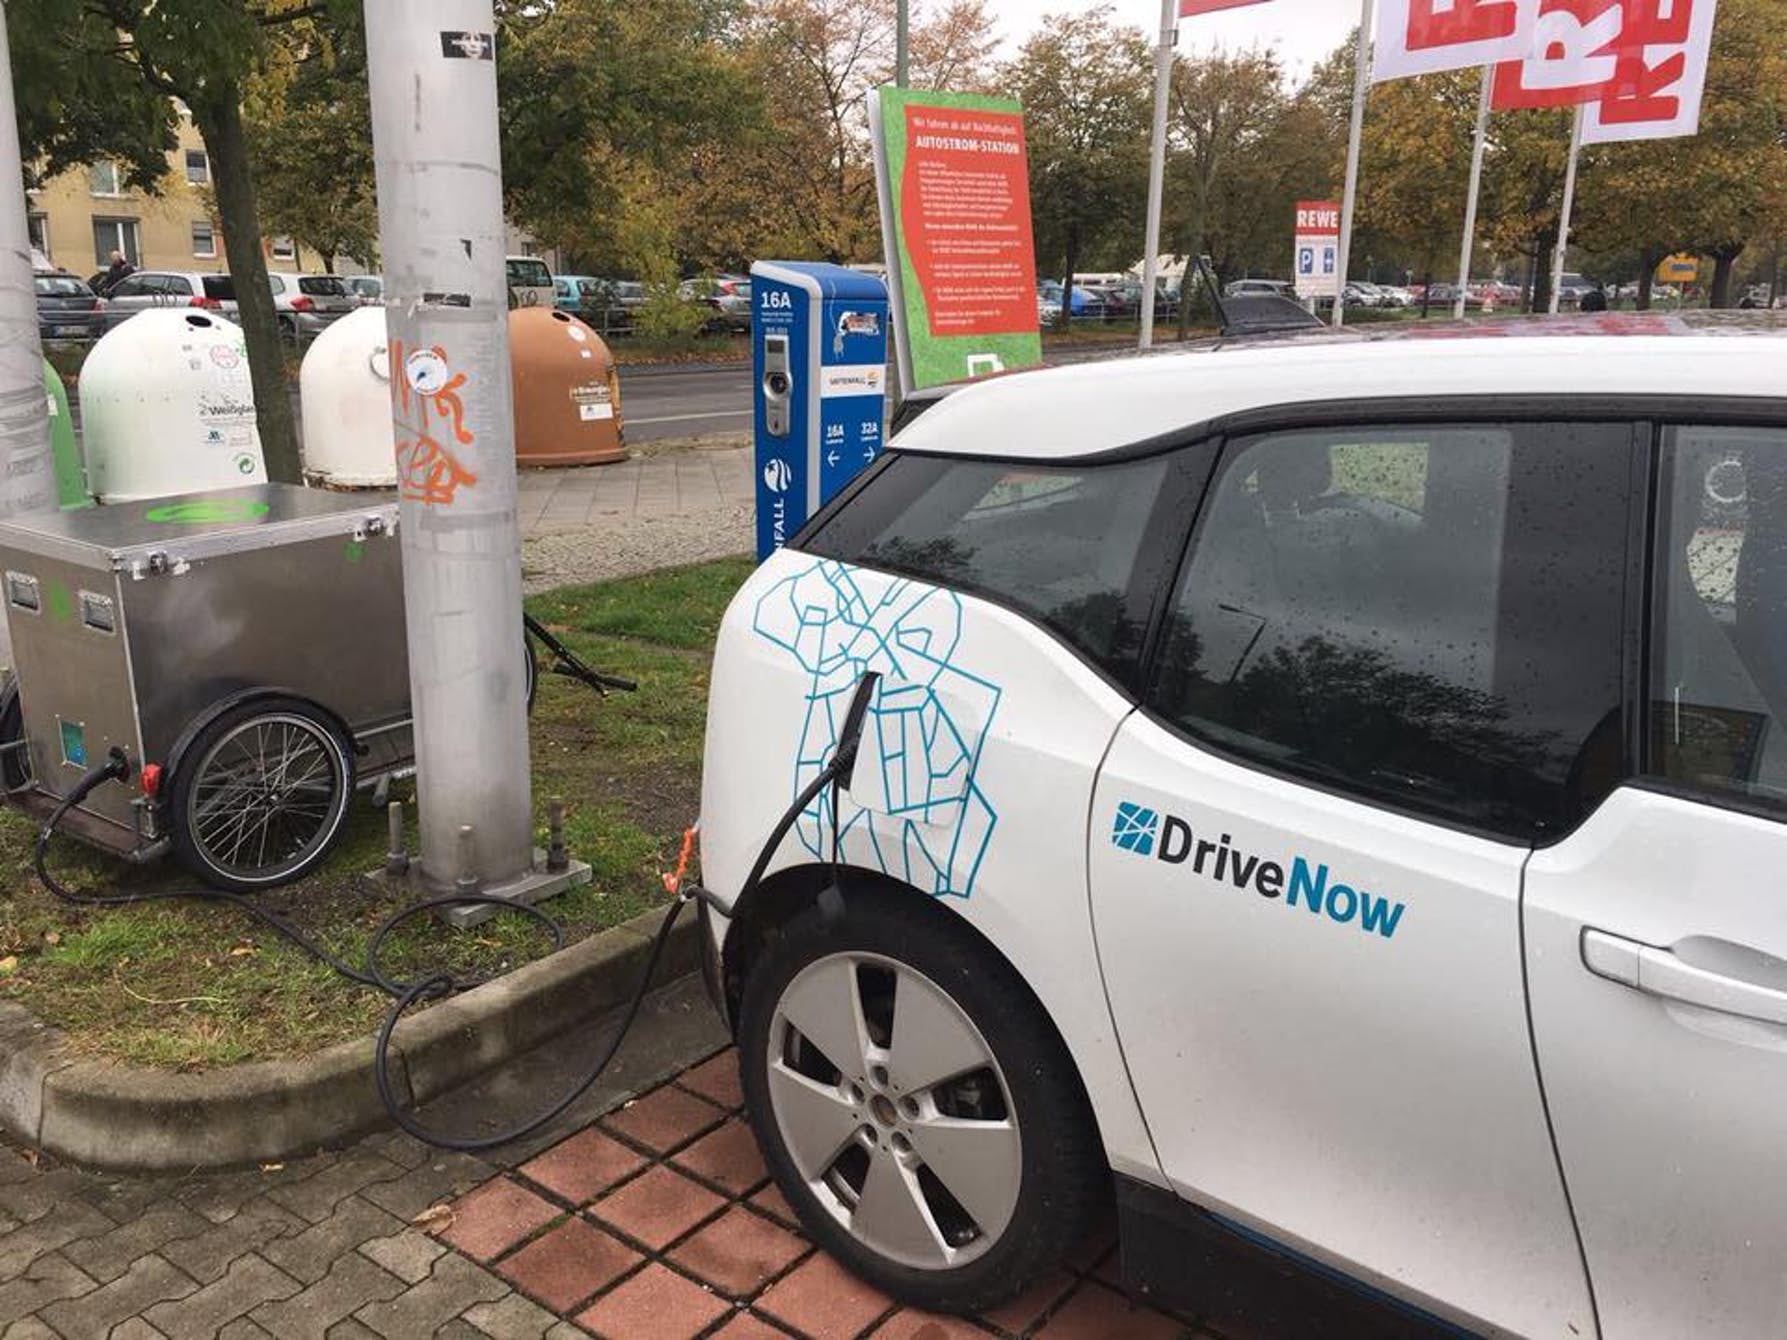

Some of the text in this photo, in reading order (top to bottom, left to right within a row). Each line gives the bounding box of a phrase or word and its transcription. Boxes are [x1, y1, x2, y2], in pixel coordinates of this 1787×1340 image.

[916, 136, 1020, 155] AUTOSTROM-STATION
[1297, 209, 1338, 228] REWE
[761, 291, 792, 309] 16A
[861, 422, 878, 434] 32A
[1157, 814, 1405, 939] DriveNow
